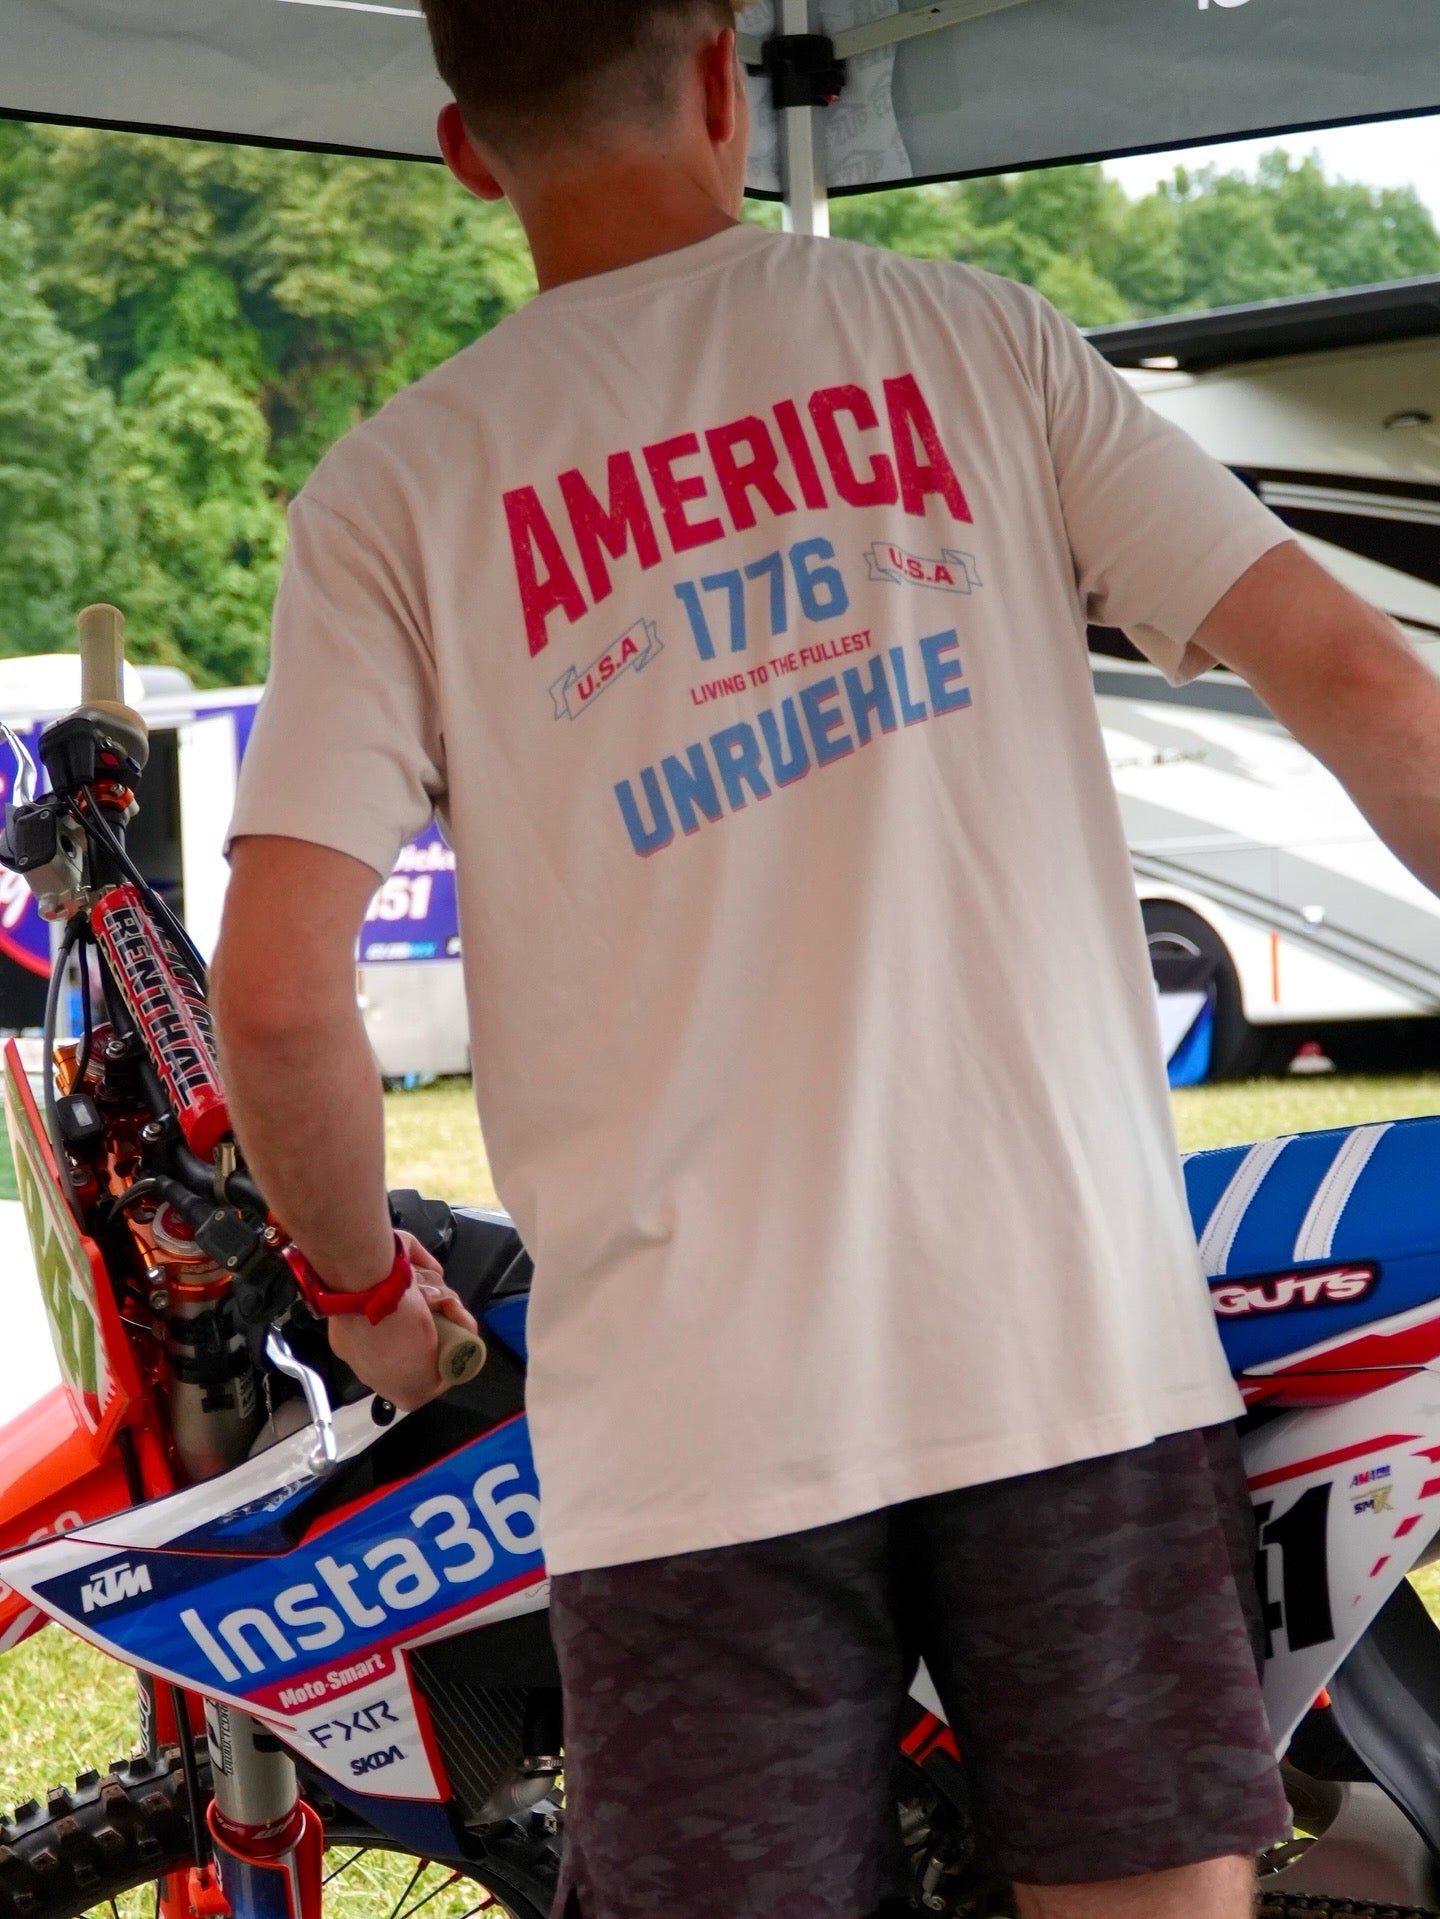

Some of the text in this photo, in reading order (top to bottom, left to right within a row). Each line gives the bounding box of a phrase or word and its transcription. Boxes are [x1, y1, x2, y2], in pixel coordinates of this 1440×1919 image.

[502, 373, 974, 658] AMERICA
[674, 537, 849, 661] 1776
[888, 546, 955, 586] U.S.A
[577, 635, 639, 701] U.S.A
[690, 629, 872, 706] LIVING TO THE FULLEST
[613, 629, 973, 858] UNRUEHLE
[103, 906, 213, 1111] RENTHAL
[1209, 1268, 1374, 1316] GUTS
[81, 1562, 152, 1613] KTM
[179, 1462, 542, 1684] Insta36
[307, 1700, 400, 1749] FXR
[350, 1744, 406, 1776] SKDA
